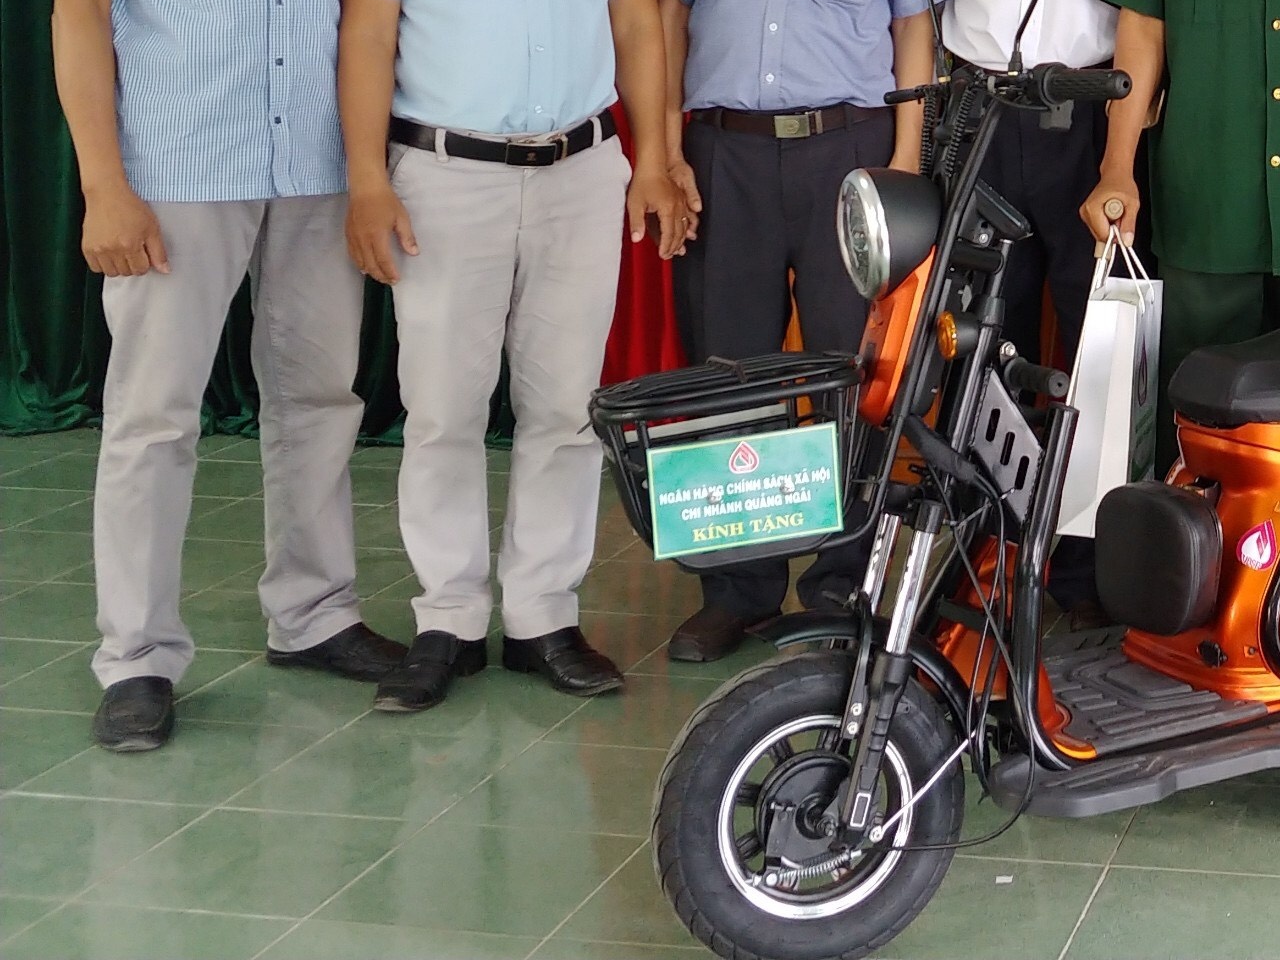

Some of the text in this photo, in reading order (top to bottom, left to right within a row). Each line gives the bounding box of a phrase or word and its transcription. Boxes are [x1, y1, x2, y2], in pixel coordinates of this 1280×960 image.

[659, 489, 691, 506] NGÂN
[726, 477, 761, 495] CHÍNH
[795, 468, 809, 484] XÃ
[811, 466, 830, 484] HỘI
[681, 507, 701, 521] CHI
[703, 500, 743, 518] NHÁNH
[693, 512, 805, 543] KÍNH TẶNG
